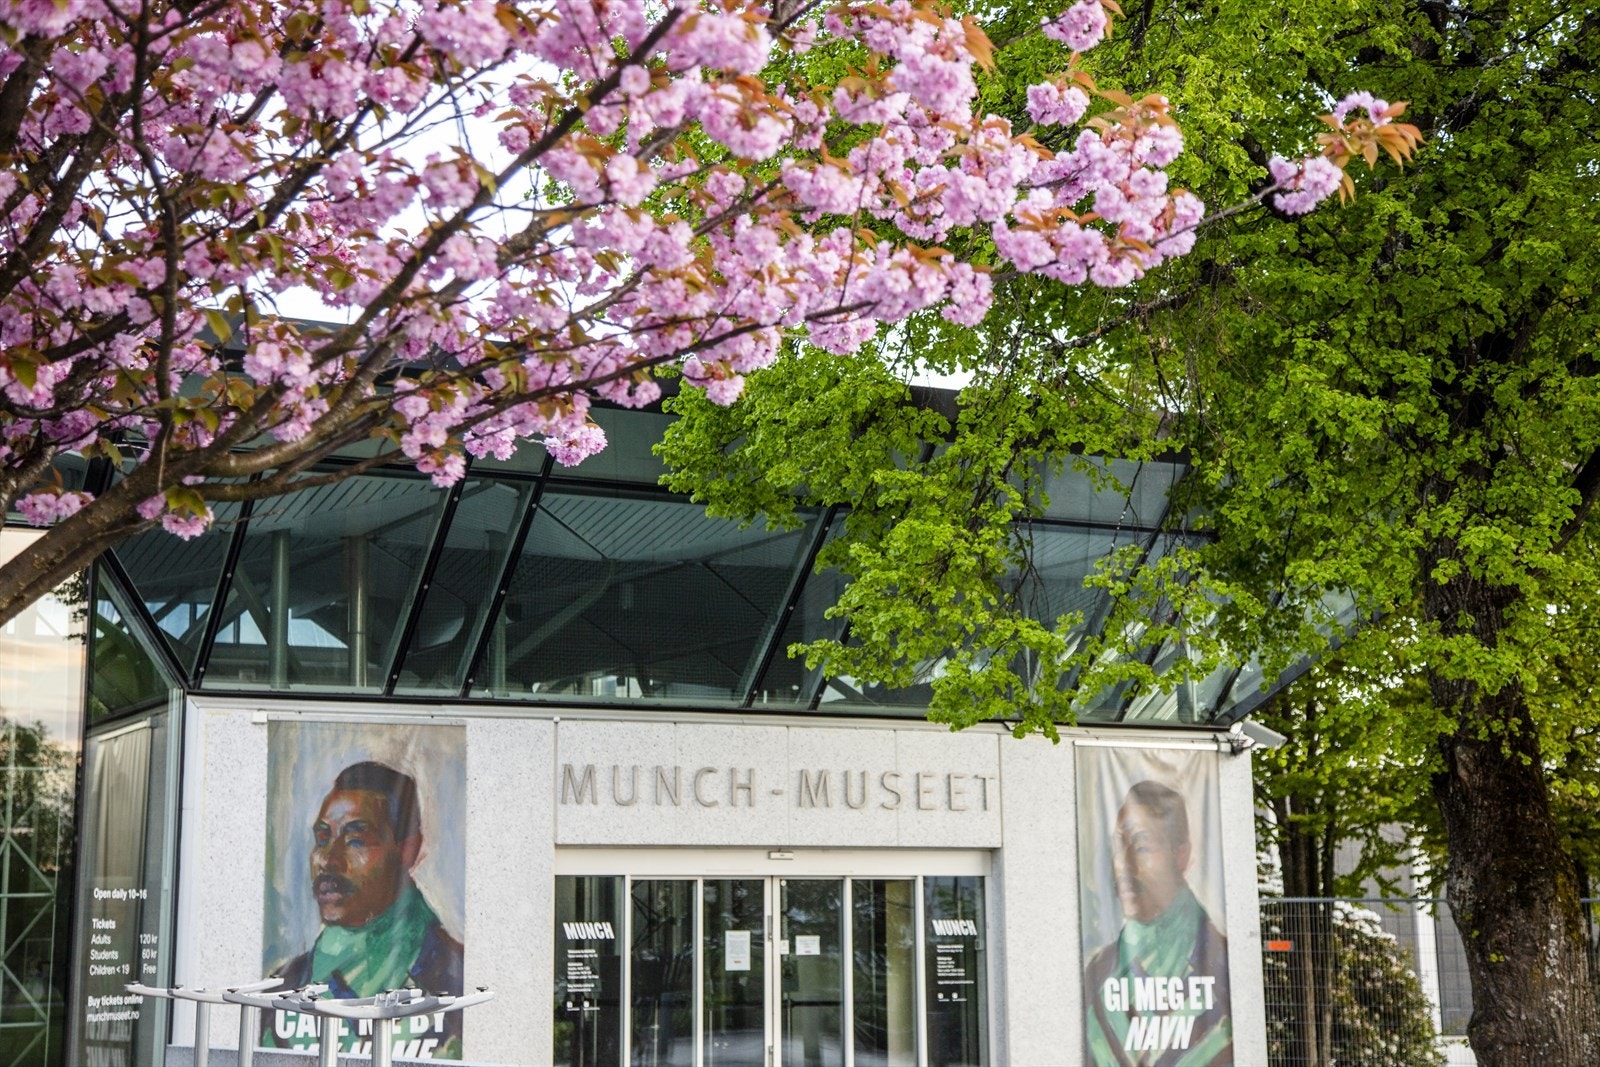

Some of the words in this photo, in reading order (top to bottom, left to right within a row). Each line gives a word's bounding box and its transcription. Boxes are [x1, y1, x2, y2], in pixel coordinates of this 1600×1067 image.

[93, 887, 111, 901] Open
[112, 888, 127, 901] daily
[92, 918, 116, 929] Tickets
[563, 922, 615, 939] MUNCH
[932, 919, 977, 935] MUNCH
[91, 934, 112, 944] Adults
[140, 934, 151, 944] 120
[151, 934, 158, 944] kr
[90, 949, 119, 960] Students
[142, 949, 150, 959] 60
[151, 949, 157, 959] kr
[89, 965, 115, 976] Children
[122, 964, 130, 975] 19
[143, 963, 156, 974] Free
[88, 995, 101, 1008] Buy
[101, 995, 123, 1006] tickets
[124, 994, 143, 1005] online
[1104, 977, 1129, 1012] GI
[1134, 976, 1185, 1011] MEG
[1188, 976, 1215, 1010] ET
[1124, 1015, 1196, 1051] NAVN
